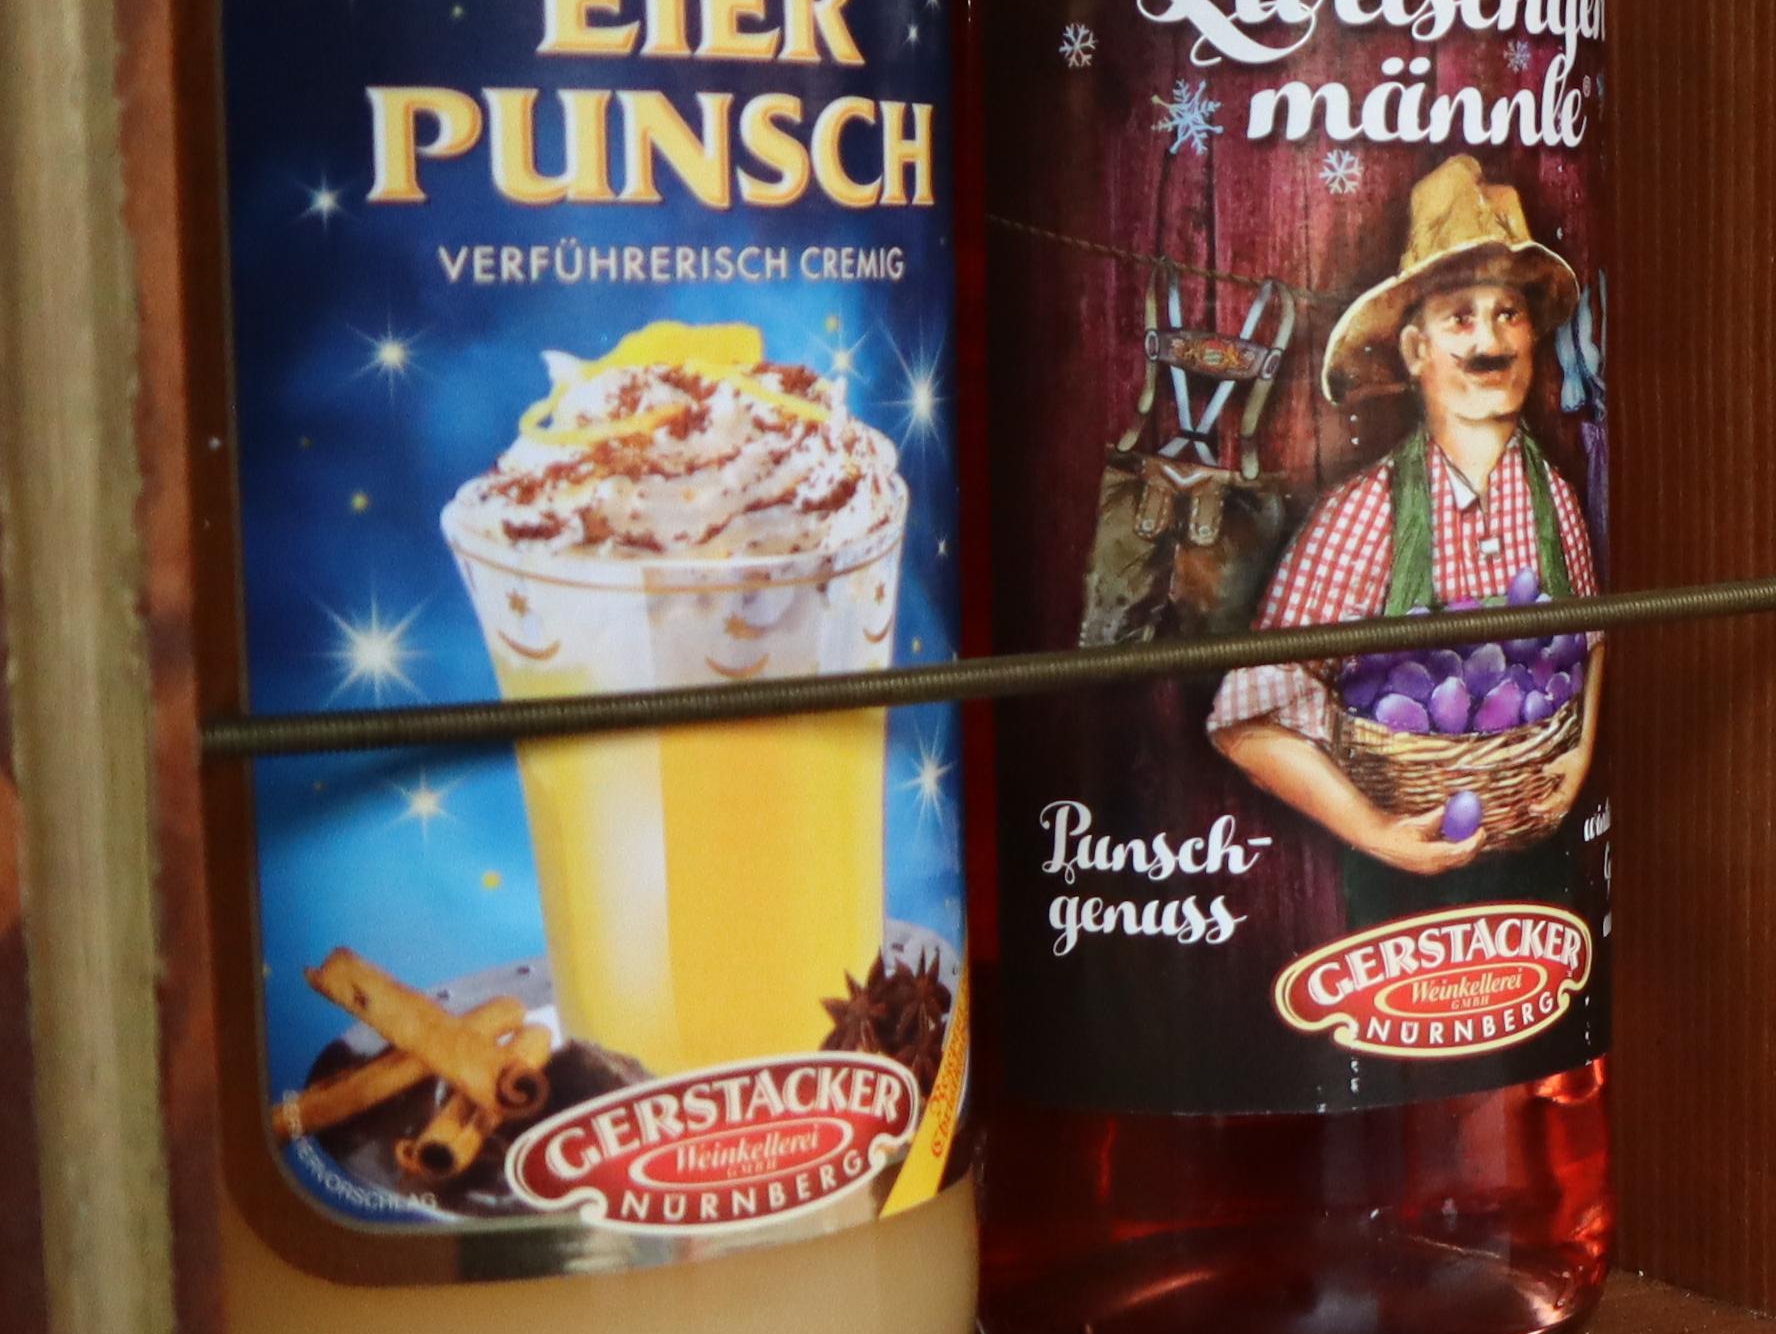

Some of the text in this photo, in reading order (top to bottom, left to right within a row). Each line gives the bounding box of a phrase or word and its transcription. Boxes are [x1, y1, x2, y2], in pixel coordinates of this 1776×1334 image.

[1247, 53, 1586, 148] männle
[366, 86, 935, 210] PUNSCH
[438, 237, 905, 284] VERFÜHRERISCH CREMIG
[1040, 800, 1273, 884] Punsch-
[1049, 895, 1248, 957] genuss
[1308, 918, 1582, 1006] GERSTACKER
[1367, 991, 1554, 1044] NÜRNBERG
[1411, 968, 1523, 1004] Weinkellerei
[545, 1067, 903, 1180] GERSTACKER
[675, 1124, 819, 1174] Weinkellerei
[620, 1149, 863, 1222] NÜRNBERG
